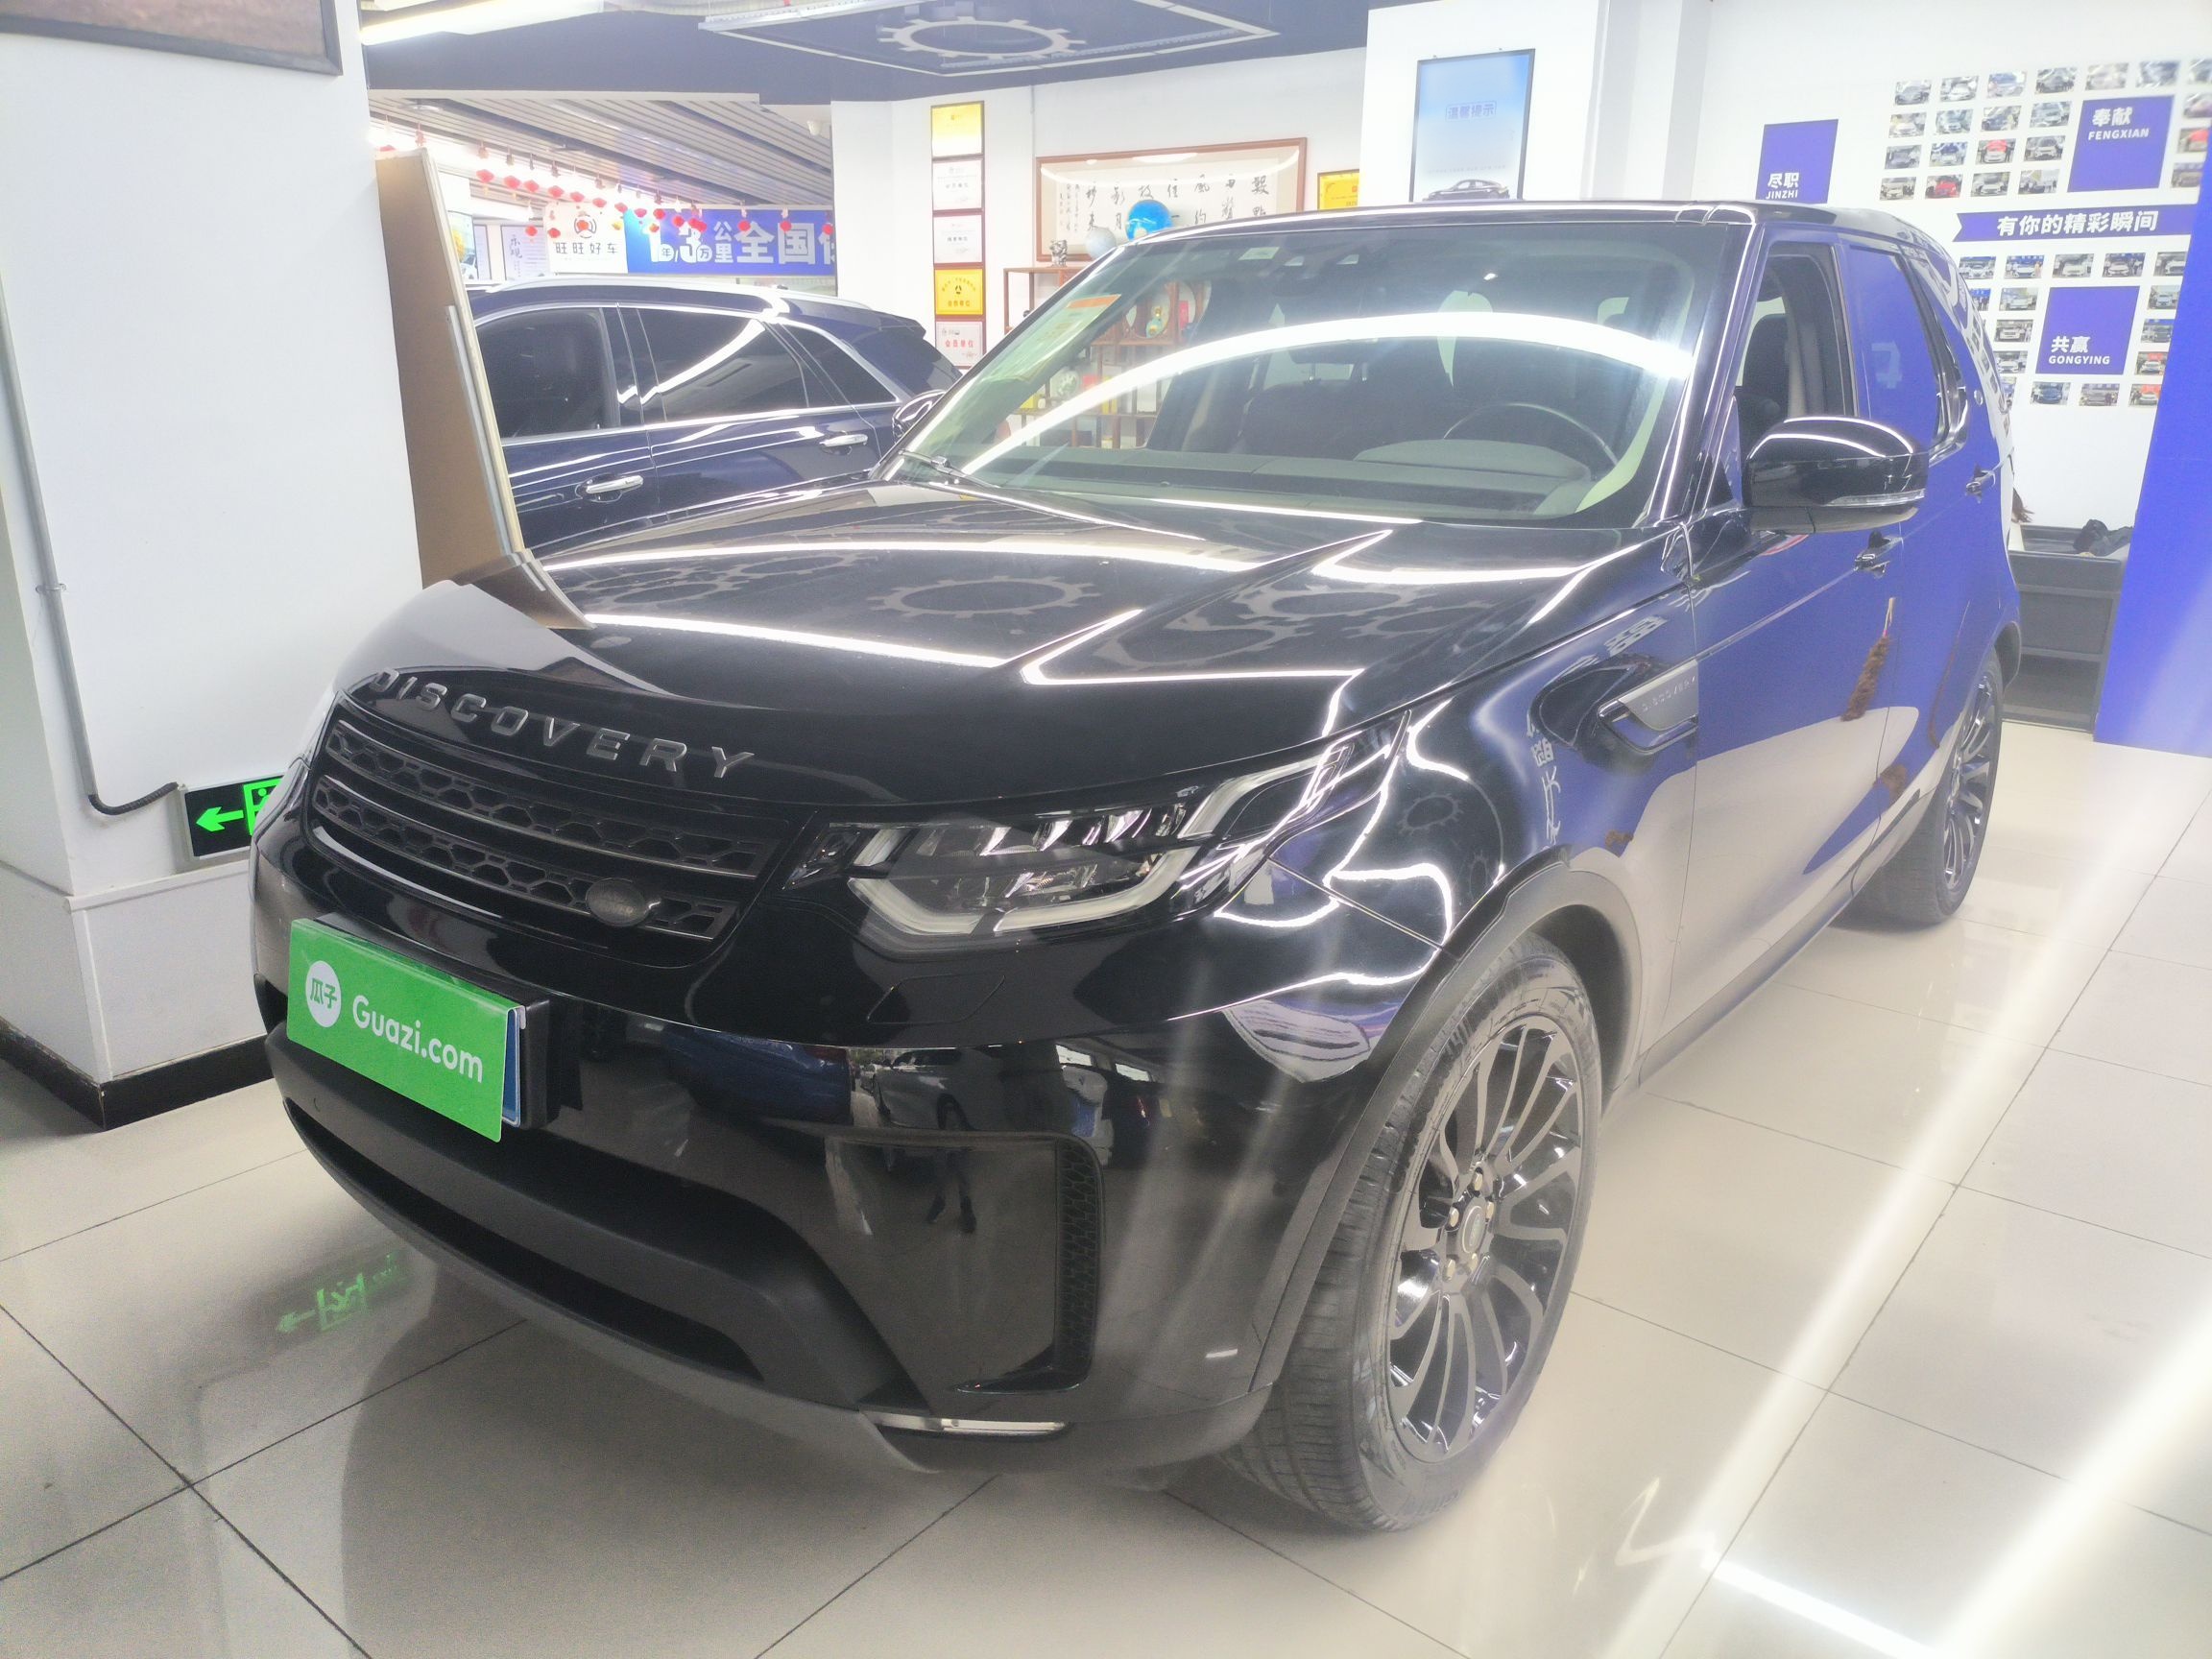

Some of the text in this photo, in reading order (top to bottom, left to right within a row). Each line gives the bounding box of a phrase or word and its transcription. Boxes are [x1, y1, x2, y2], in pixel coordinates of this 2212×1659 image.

[1448, 104, 1494, 119] 温馨提示
[2092, 107, 2132, 127] 奉献
[2088, 128, 2150, 140] FENGXIAN
[1767, 172, 1799, 189] 尽职
[1766, 189, 1798, 200] JINZHI
[1997, 210, 2159, 237] 有你的精彩瞬间
[555, 241, 618, 255] 旺旺好车
[2051, 335, 2091, 353] 共赢
[2048, 355, 2110, 365] GONGYING
[369, 669, 755, 780] DISCOVERY
[309, 977, 337, 1009] 瓜子
[352, 995, 483, 1084] Guazi.com
